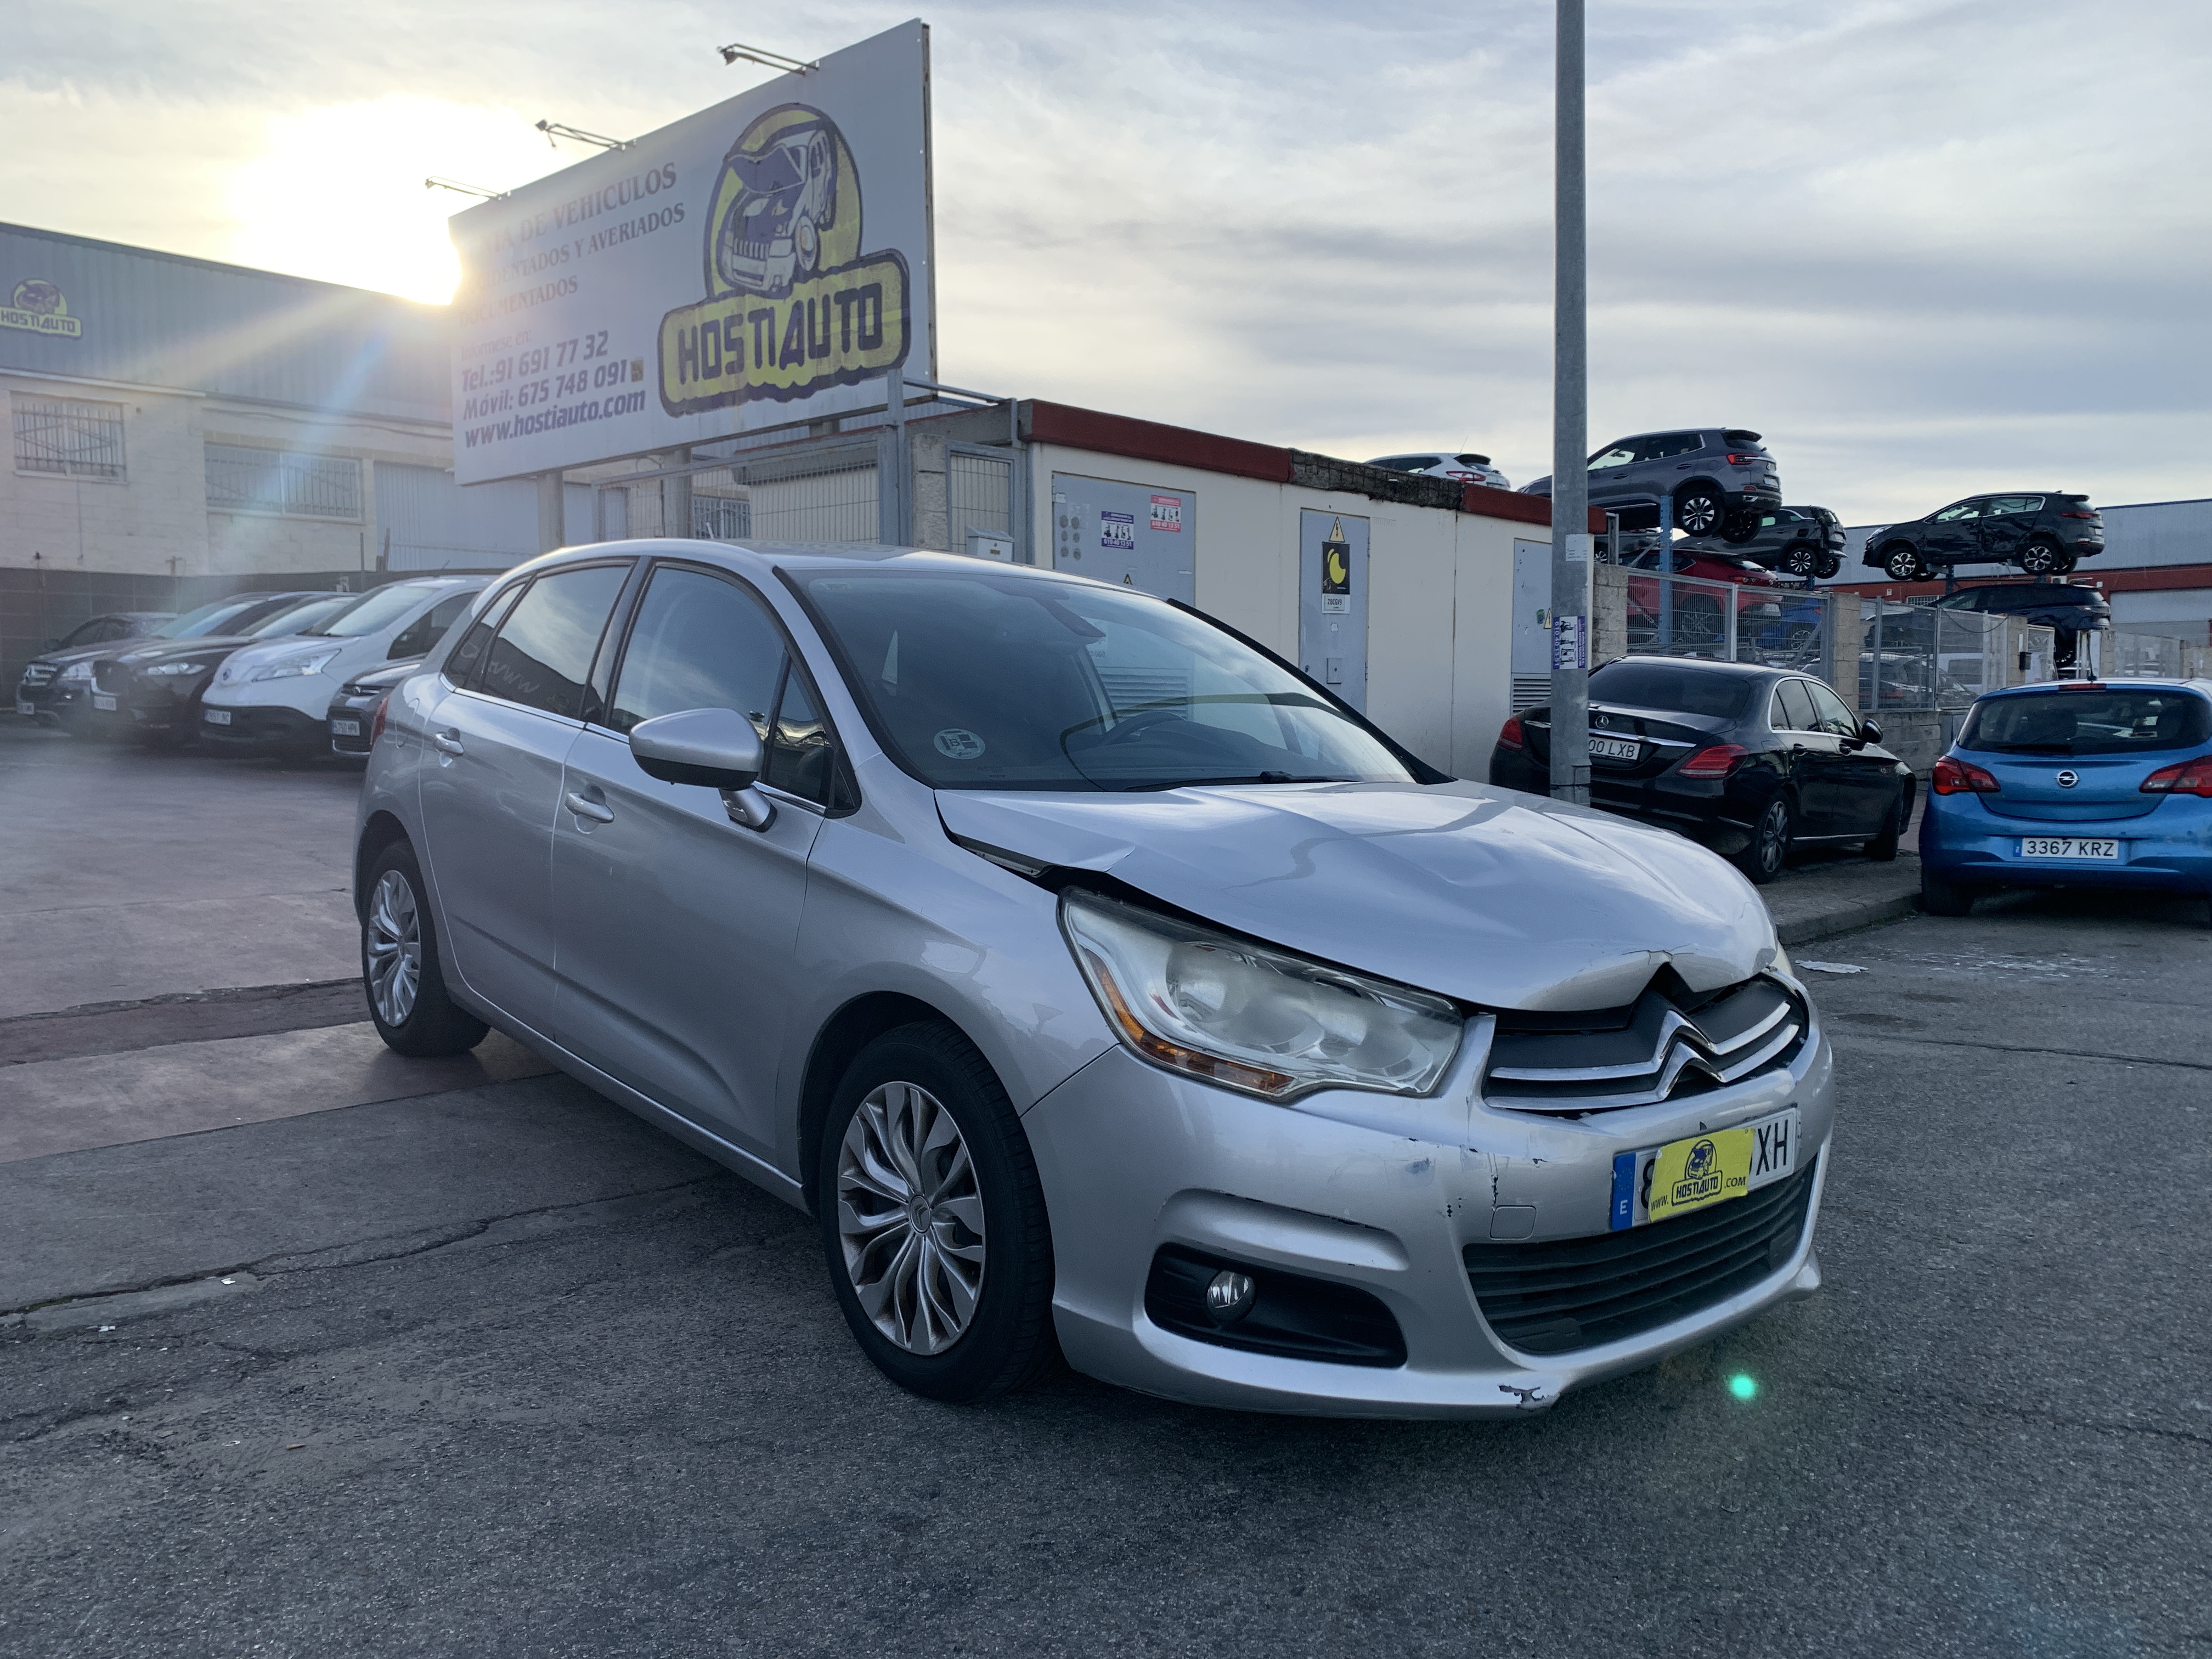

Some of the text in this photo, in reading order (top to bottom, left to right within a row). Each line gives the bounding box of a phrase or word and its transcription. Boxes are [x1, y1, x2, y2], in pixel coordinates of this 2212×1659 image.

[521, 212, 547, 244] DE
[553, 162, 676, 231] VEHICULOS
[573, 238, 585, 259] Y
[588, 202, 685, 255] AVERIADOS
[1, 310, 76, 332] HOSTIAUTO
[679, 282, 882, 385] HOSTIAUTO
[519, 346, 550, 377] 691
[556, 338, 579, 368] 77
[583, 330, 608, 360] 32
[464, 359, 627, 421] Móvil: 675 748 091
[465, 390, 646, 448] www.hostiauto.com
[949, 738, 960, 747] B
[1589, 739, 1635, 758] 00 LXB
[2027, 840, 2073, 855] 3367
[2079, 842, 2114, 856] KRZ
[1754, 1119, 1789, 1176] XH
[1620, 1199, 1628, 1215] E
[1676, 1176, 1718, 1199] HOSTIAUTO
